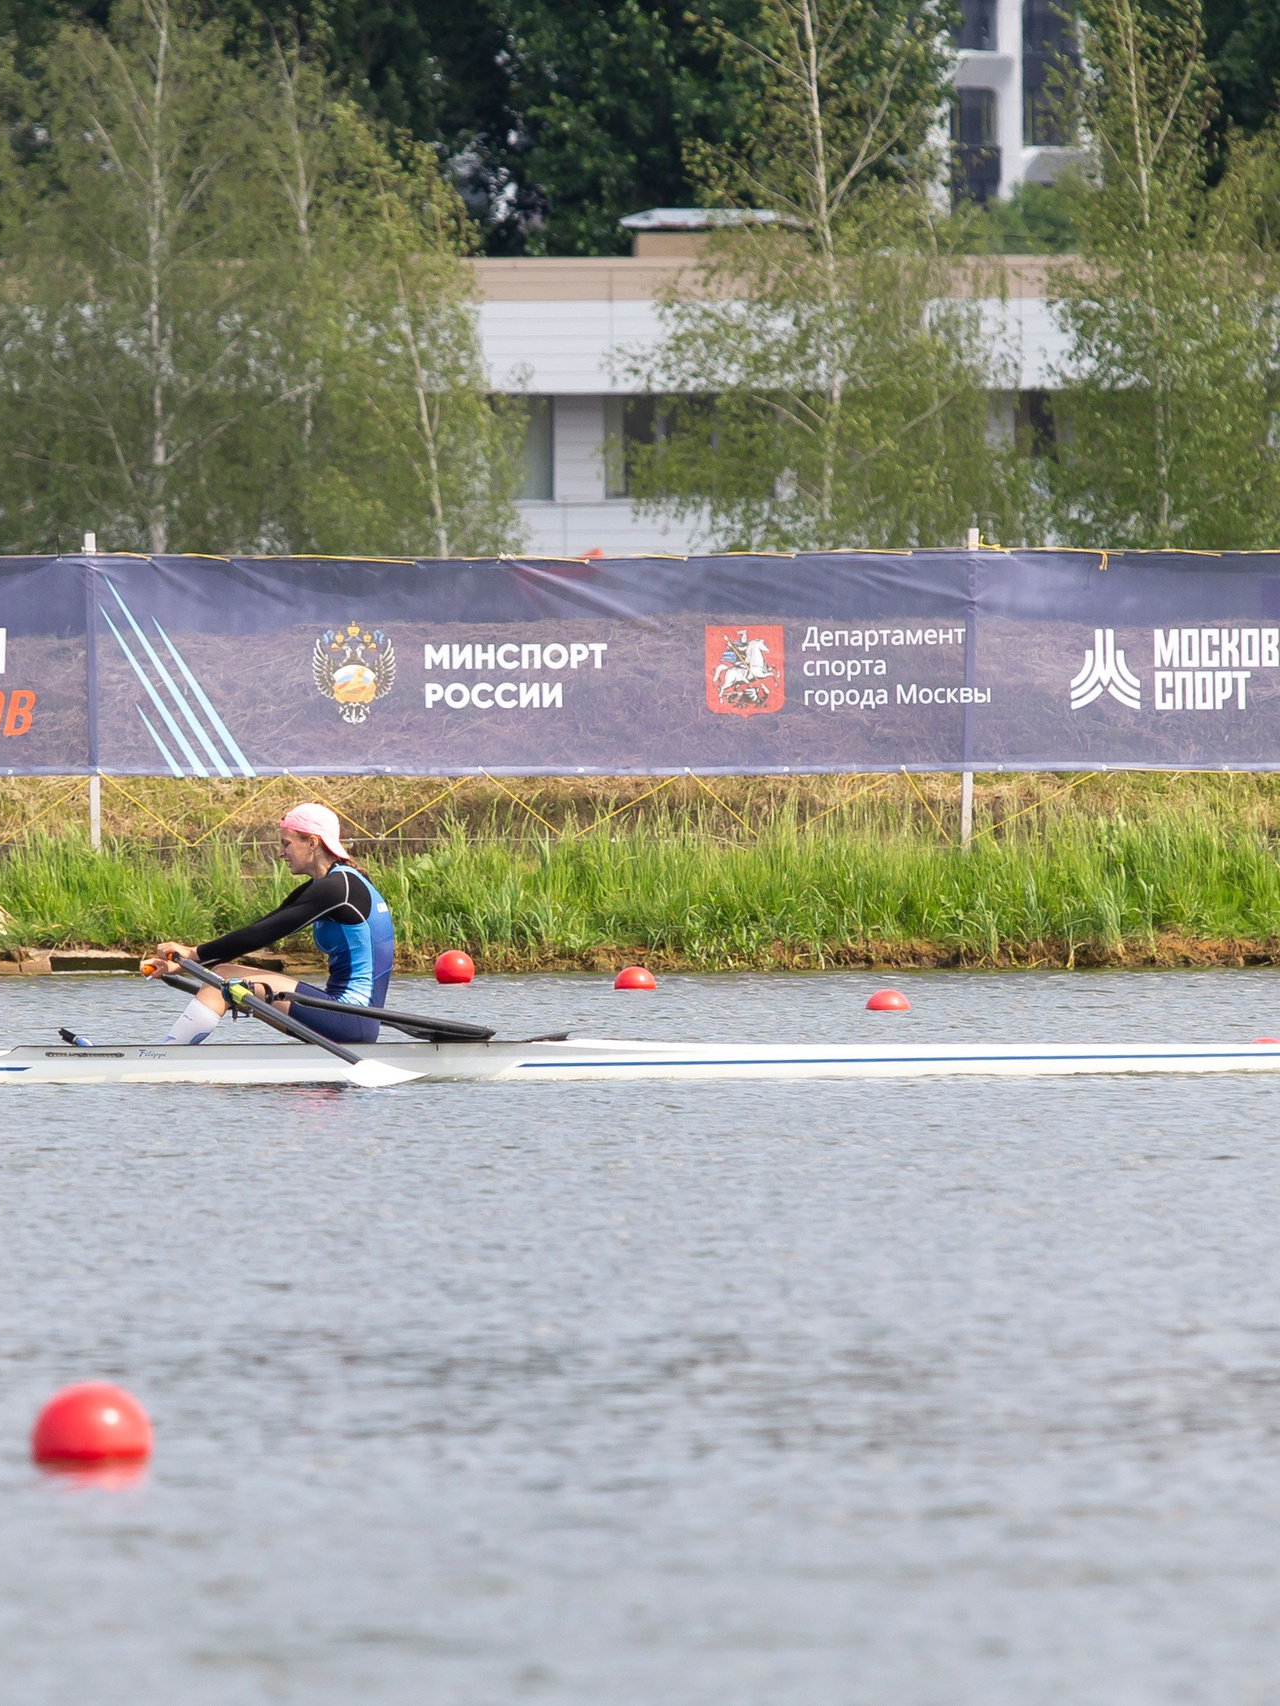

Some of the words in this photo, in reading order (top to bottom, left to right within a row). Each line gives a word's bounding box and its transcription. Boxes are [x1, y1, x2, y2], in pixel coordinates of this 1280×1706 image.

[801, 626, 967, 652] Департамент
[1153, 628, 1280, 668] МОСКОВ
[424, 642, 608, 670] МИНСПОРТ
[802, 659, 887, 682] спорта
[424, 682, 563, 709] РОССИИ
[803, 688, 889, 711] города
[896, 684, 992, 705] Москвы
[1154, 670, 1252, 711] СПОРТ
